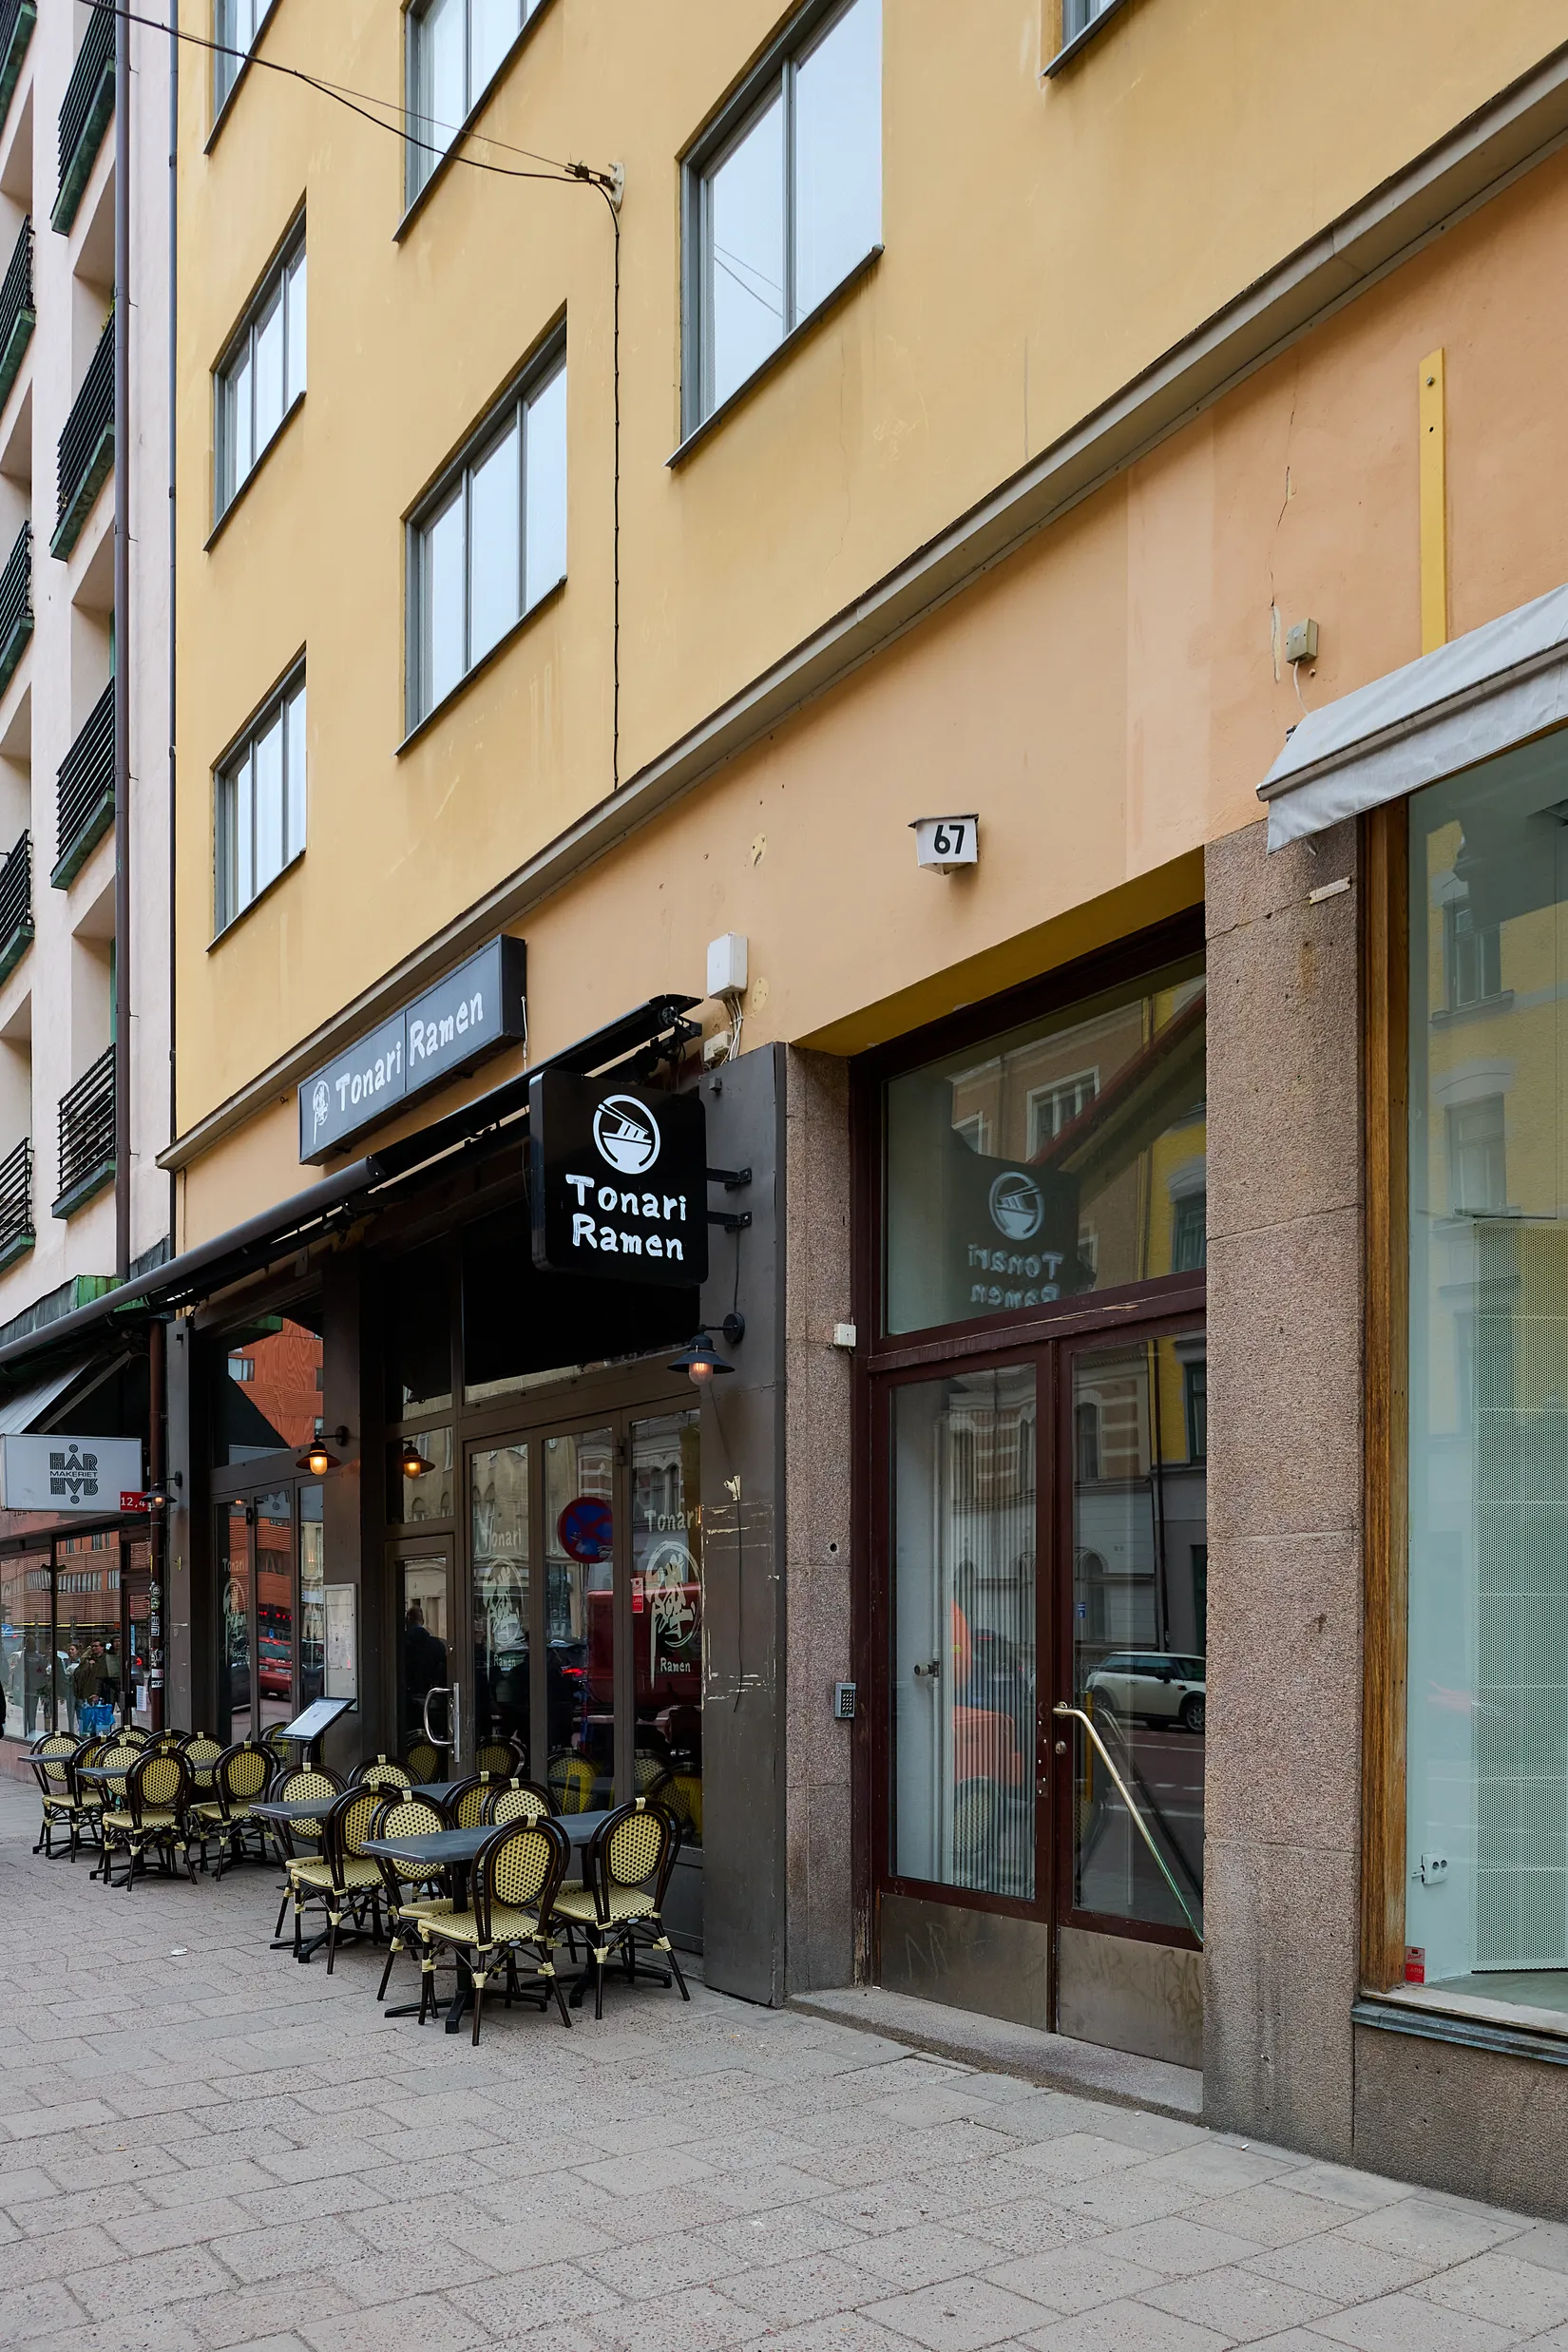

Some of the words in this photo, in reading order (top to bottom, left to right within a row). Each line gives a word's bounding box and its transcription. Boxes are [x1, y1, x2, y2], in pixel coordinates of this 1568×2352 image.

[934, 825, 965, 854] 67
[335, 1041, 402, 1112] Tonari
[410, 992, 484, 1066] Ramen
[565, 1174, 686, 1221] Tonari
[572, 1213, 684, 1261] Ramen
[644, 1507, 699, 1533] Tonari
[660, 1656, 691, 1673] Ramen
